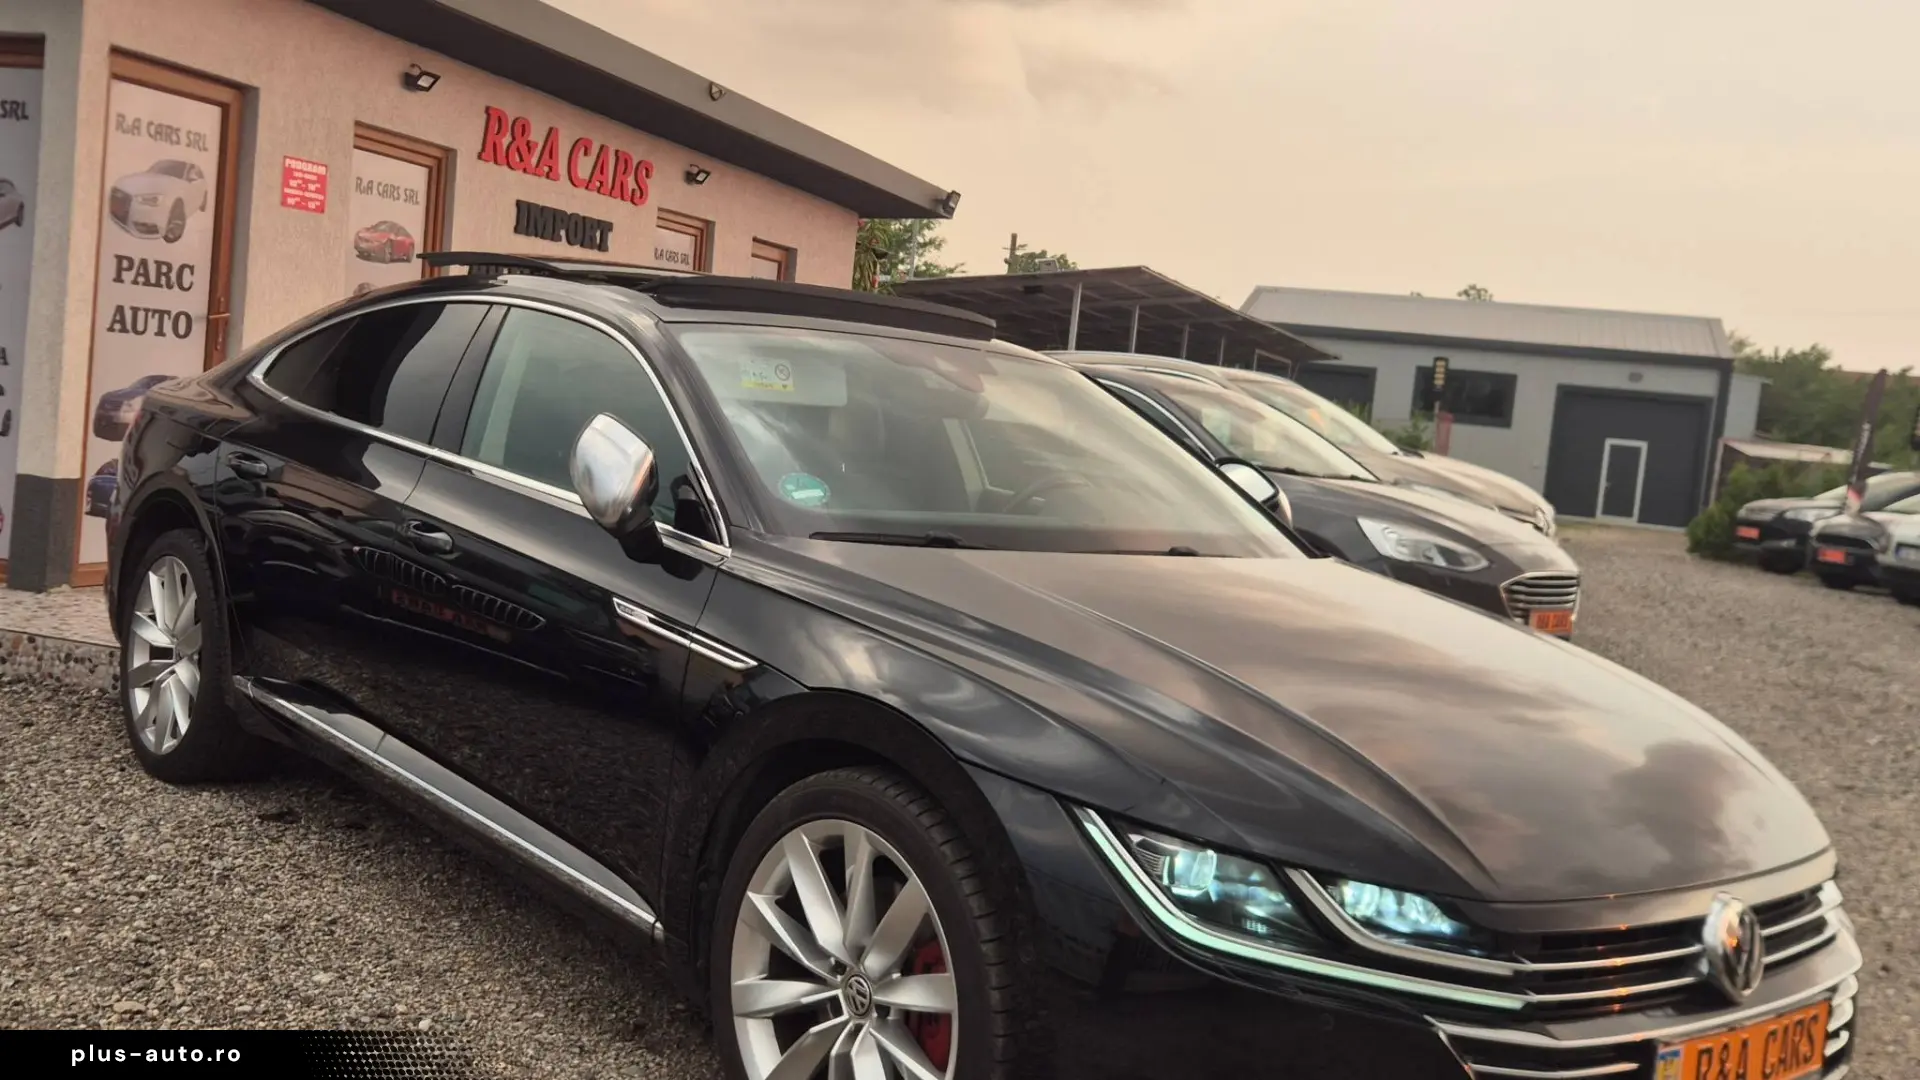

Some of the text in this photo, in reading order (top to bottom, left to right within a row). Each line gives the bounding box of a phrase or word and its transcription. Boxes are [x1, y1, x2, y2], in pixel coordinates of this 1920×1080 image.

[146, 120, 182, 146] CARS
[185, 128, 209, 152] SRL
[284, 158, 327, 175] PROGRAM
[478, 106, 655, 206] R&A CARS
[376, 181, 401, 202] CARS
[403, 187, 420, 205] SRL
[513, 199, 614, 252] IMPORT
[112, 253, 196, 292] PARC
[106, 304, 194, 340] AUTO
[1695, 1012, 1820, 1080] R&A CARS
